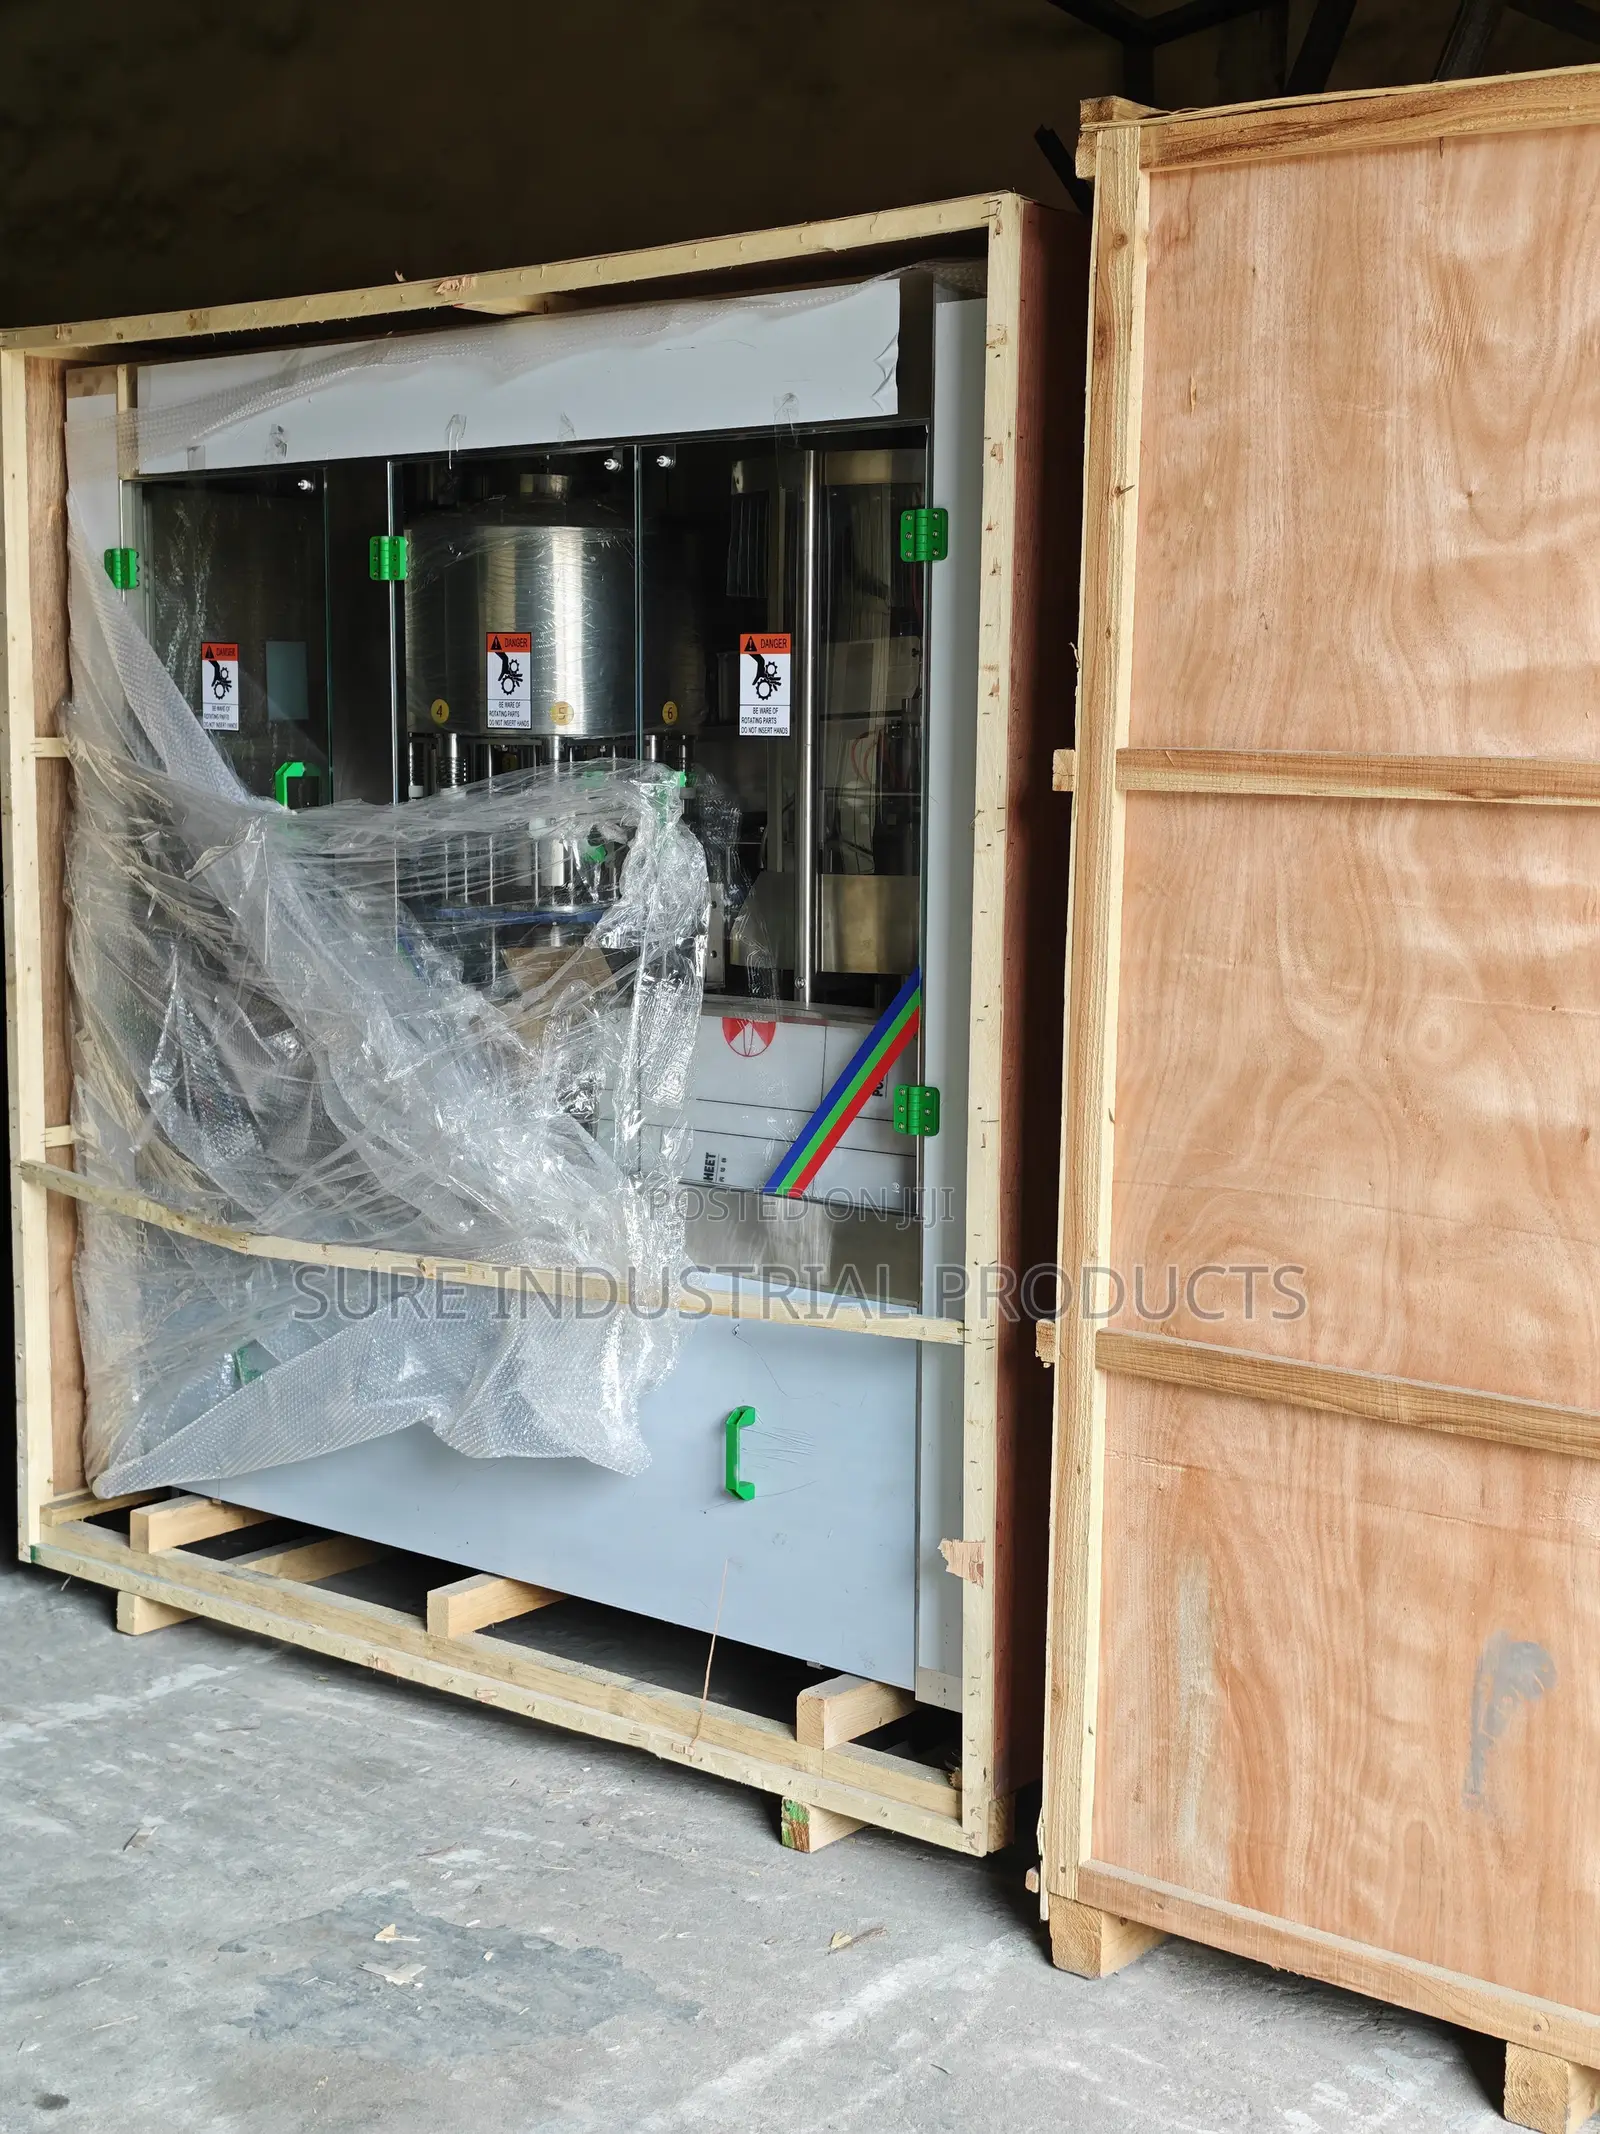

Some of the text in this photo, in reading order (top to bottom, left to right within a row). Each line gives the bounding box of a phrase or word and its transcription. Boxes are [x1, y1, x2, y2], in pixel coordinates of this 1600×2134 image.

[504, 638, 528, 648] DANGER
[760, 638, 787, 649] DANGER
[667, 706, 673, 720] 6
[763, 717, 777, 725] PARTS
